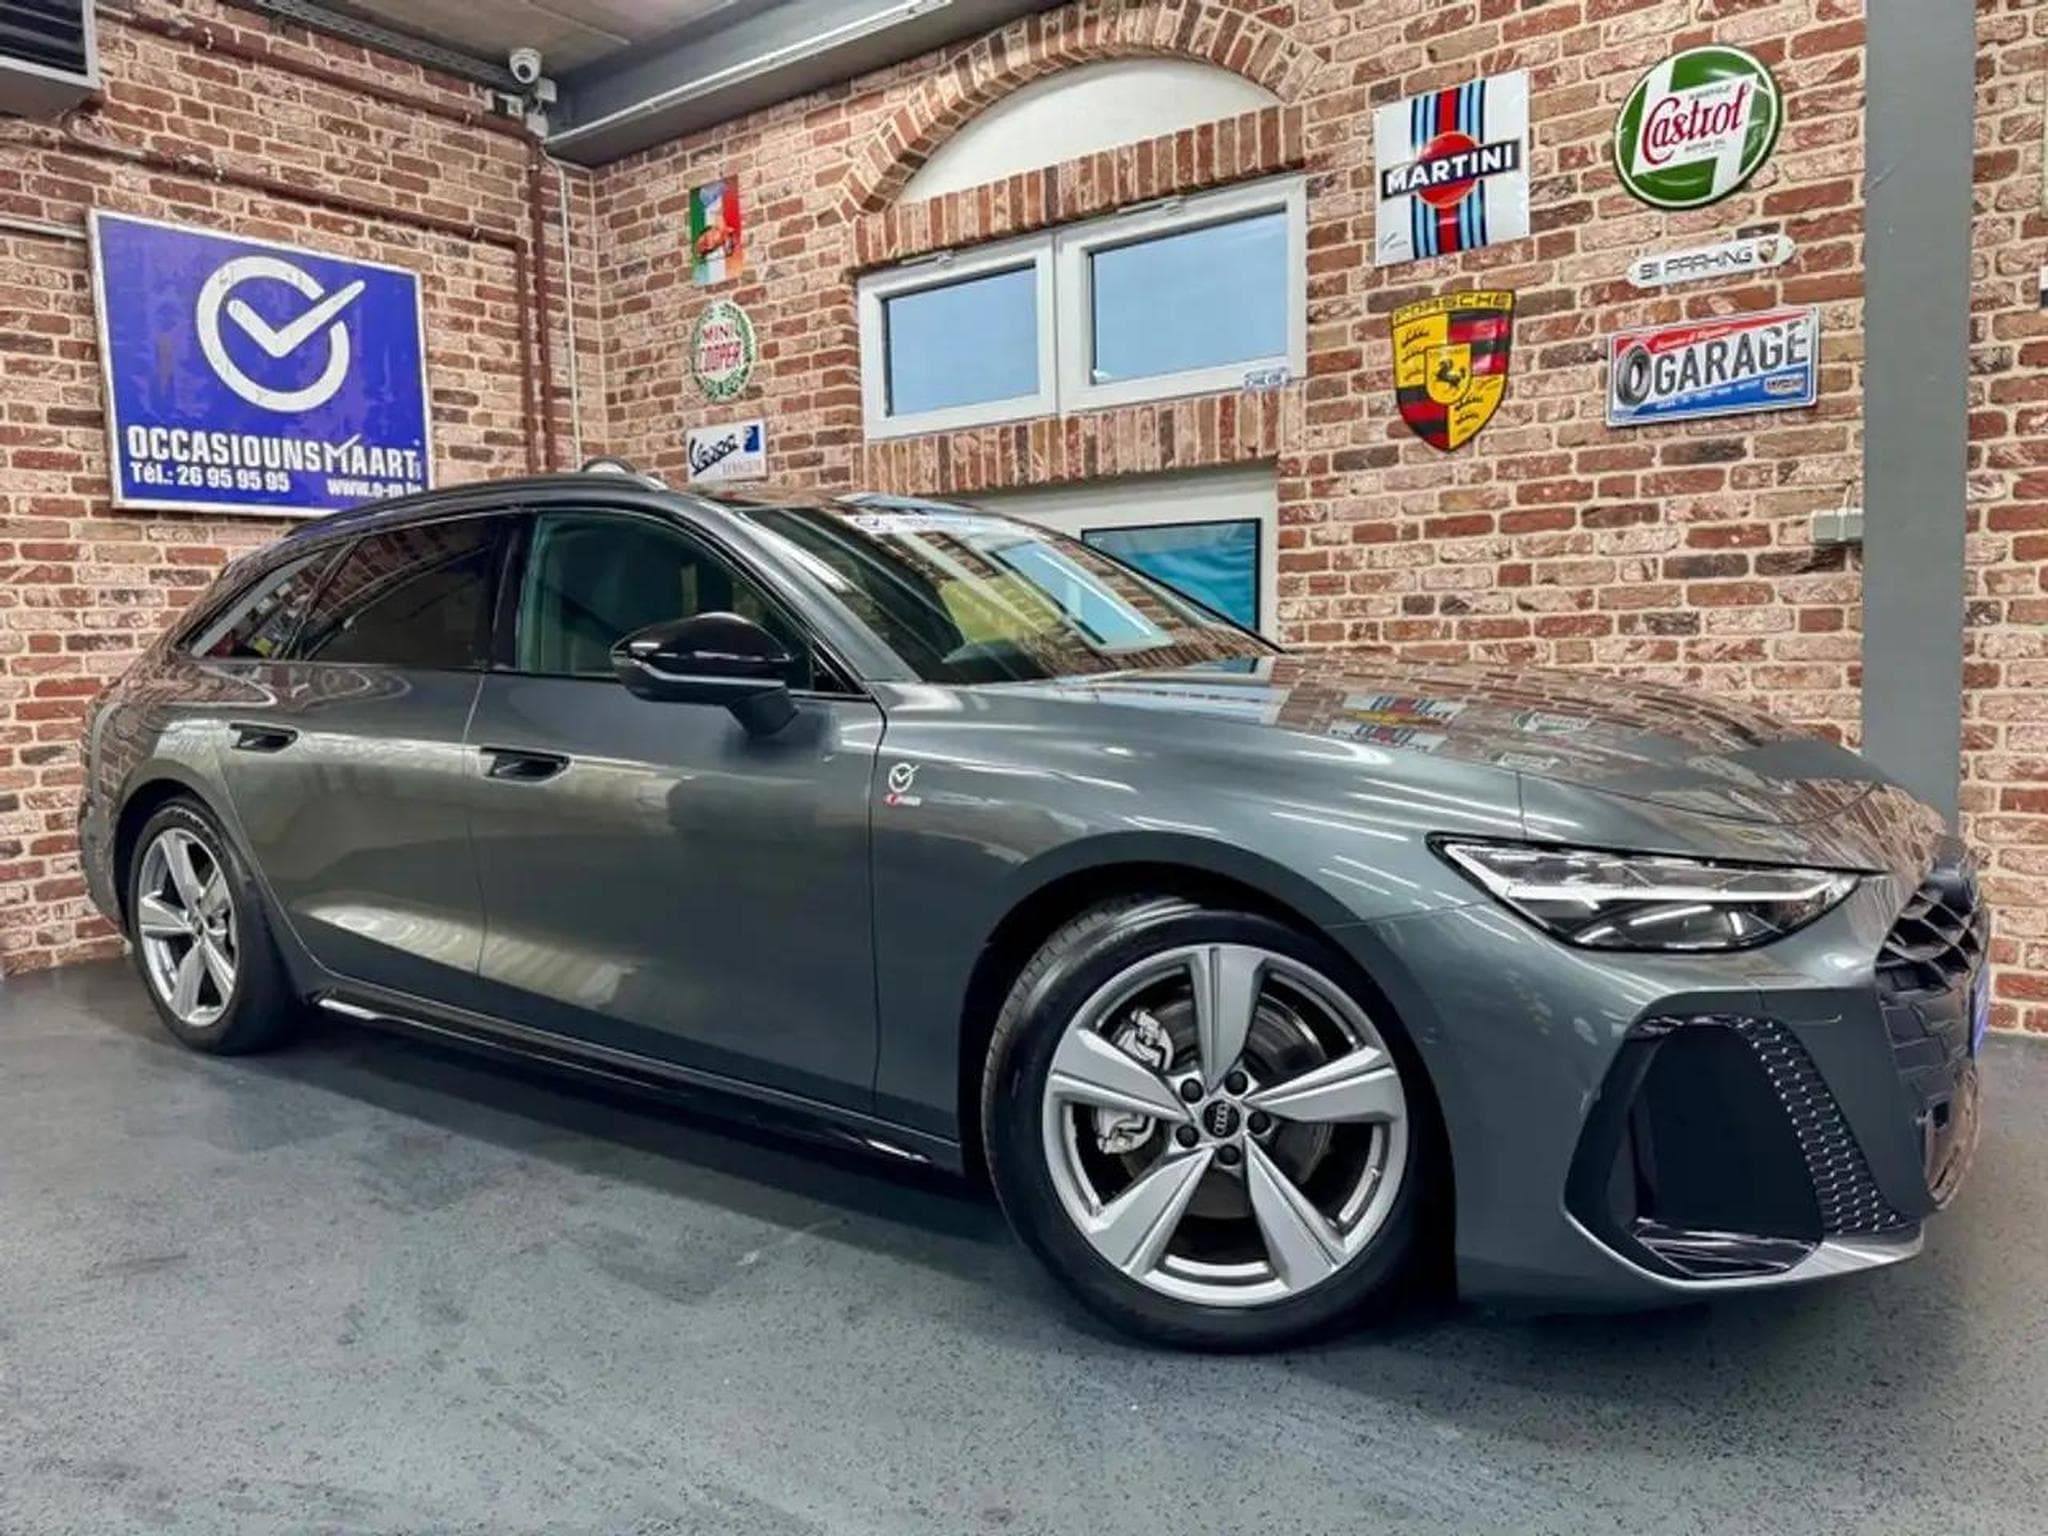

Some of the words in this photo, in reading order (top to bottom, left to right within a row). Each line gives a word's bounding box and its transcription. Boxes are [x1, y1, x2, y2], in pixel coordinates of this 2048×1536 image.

[1642, 80, 1750, 165] Castrol
[1386, 144, 1512, 194] MARTINI
[1664, 246, 1752, 276] PARKING
[1394, 291, 1511, 323] PORSCHE
[127, 425, 418, 479] OCCASIOUNSMAART
[689, 433, 739, 476] Vespa
[177, 466, 204, 488] 26
[207, 467, 233, 490] 95
[236, 469, 261, 491] 95
[265, 470, 291, 493] 95
